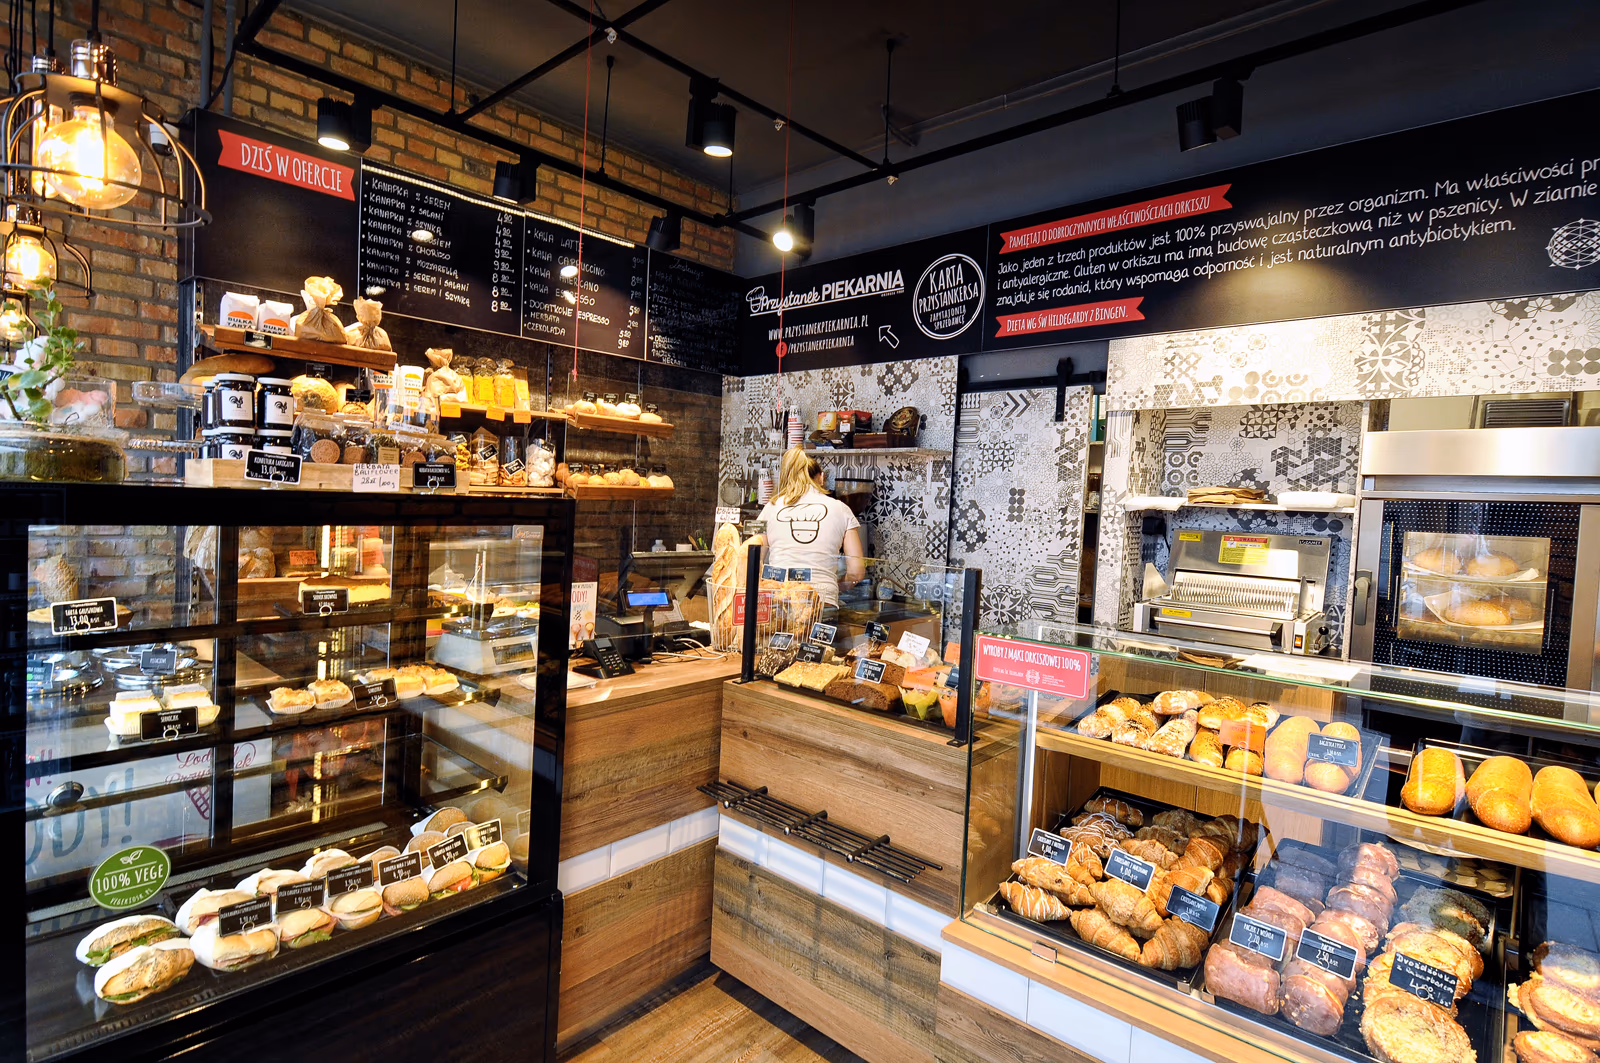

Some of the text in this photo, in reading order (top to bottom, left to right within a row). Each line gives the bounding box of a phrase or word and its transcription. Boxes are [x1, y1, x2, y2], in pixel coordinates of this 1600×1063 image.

[241, 143, 343, 193] DZIŚ W OFERCIE
[370, 192, 406, 210] KANAPKA
[411, 205, 416, 213] Z
[372, 178, 409, 198] KANAPKA
[416, 192, 421, 201] Z
[424, 195, 450, 210] SEREM
[368, 218, 402, 235] KANAPKA
[369, 205, 404, 222] KANAPKA
[408, 218, 413, 226] Z
[415, 220, 442, 236] SZYNKĄ
[997, 262, 1019, 275] Jako
[1020, 256, 1045, 273] jeden
[1047, 256, 1054, 266] z
[1057, 248, 1086, 264] trzech
[1089, 238, 1146, 263] produktów
[1149, 231, 1171, 250] jest
[1175, 224, 1206, 242] 100%
[1210, 210, 1301, 241] przyswajalny
[1304, 202, 1344, 225] przez
[1348, 188, 1430, 213] organizm.
[1434, 180, 1461, 198] Ma
[1466, 158, 1575, 191] właściwości
[1009, 230, 1042, 249] PAMIĘTAJ
[1048, 217, 1106, 240] DOBROCZYNNYCH
[1107, 204, 1173, 229] WŁAŚCIWOŚCIACH
[1175, 195, 1211, 215] ORKISZU
[368, 232, 403, 249] KANAPKA
[533, 228, 584, 253] KAWA LATTE
[1002, 270, 1071, 290] antyalergiczne.
[1073, 261, 1106, 278] Gluten
[1108, 262, 1119, 271] w
[1122, 254, 1161, 270] orkiszu
[1165, 251, 1184, 262] ma
[1188, 245, 1213, 258] inną
[1217, 236, 1268, 255] budowę
[1271, 220, 1373, 245] cząsteczkową
[1378, 212, 1402, 228] niż
[1407, 211, 1424, 223] w
[1428, 197, 1503, 226] pszenicy.
[1509, 189, 1529, 207] W
[1533, 180, 1598, 205] ziarnie
[366, 246, 400, 262] KANAPKA
[532, 247, 552, 261] KAWA
[996, 290, 1036, 306] znajduje
[1037, 288, 1051, 301] się
[1052, 280, 1091, 297] rodanid,
[1095, 277, 1122, 291] który
[1125, 268, 1189, 289] wspomaga
[1193, 256, 1256, 280] odporność
[1266, 249, 1294, 269] jest
[1297, 239, 1385, 262] naturalnym
[1389, 219, 1517, 249] antybiotykiem.
[405, 270, 410, 278] Z
[413, 272, 437, 285] SEREM
[529, 265, 551, 279] KAWA
[930, 263, 964, 294] KARTA
[366, 274, 401, 289] KANAPKA
[405, 282, 410, 291] Z
[413, 285, 437, 296] SEREM
[529, 281, 549, 294] KAWA
[760, 269, 904, 316] Przystanek PIEKARNIA
[918, 281, 979, 314] PRZYSTANKERSA
[227, 317, 253, 325] BUŁKA
[529, 299, 610, 326] DODATKOWE ESPRESSO
[530, 312, 560, 324] HERBATA
[1006, 319, 1026, 332] DIETA
[1026, 319, 1037, 330] WG
[1048, 311, 1089, 327] HILDEGARDY
[1095, 306, 1129, 321] BINGEN.
[263, 324, 287, 332] BUŁKA
[526, 322, 566, 336] CZEKOLADA
[983, 644, 1004, 658] WYROBY
[1008, 649, 1024, 662] MĄKI
[1025, 651, 1061, 669] ORKISZOWEJ
[1062, 656, 1081, 671] 100%
[96, 863, 163, 894] 100% VEGE
